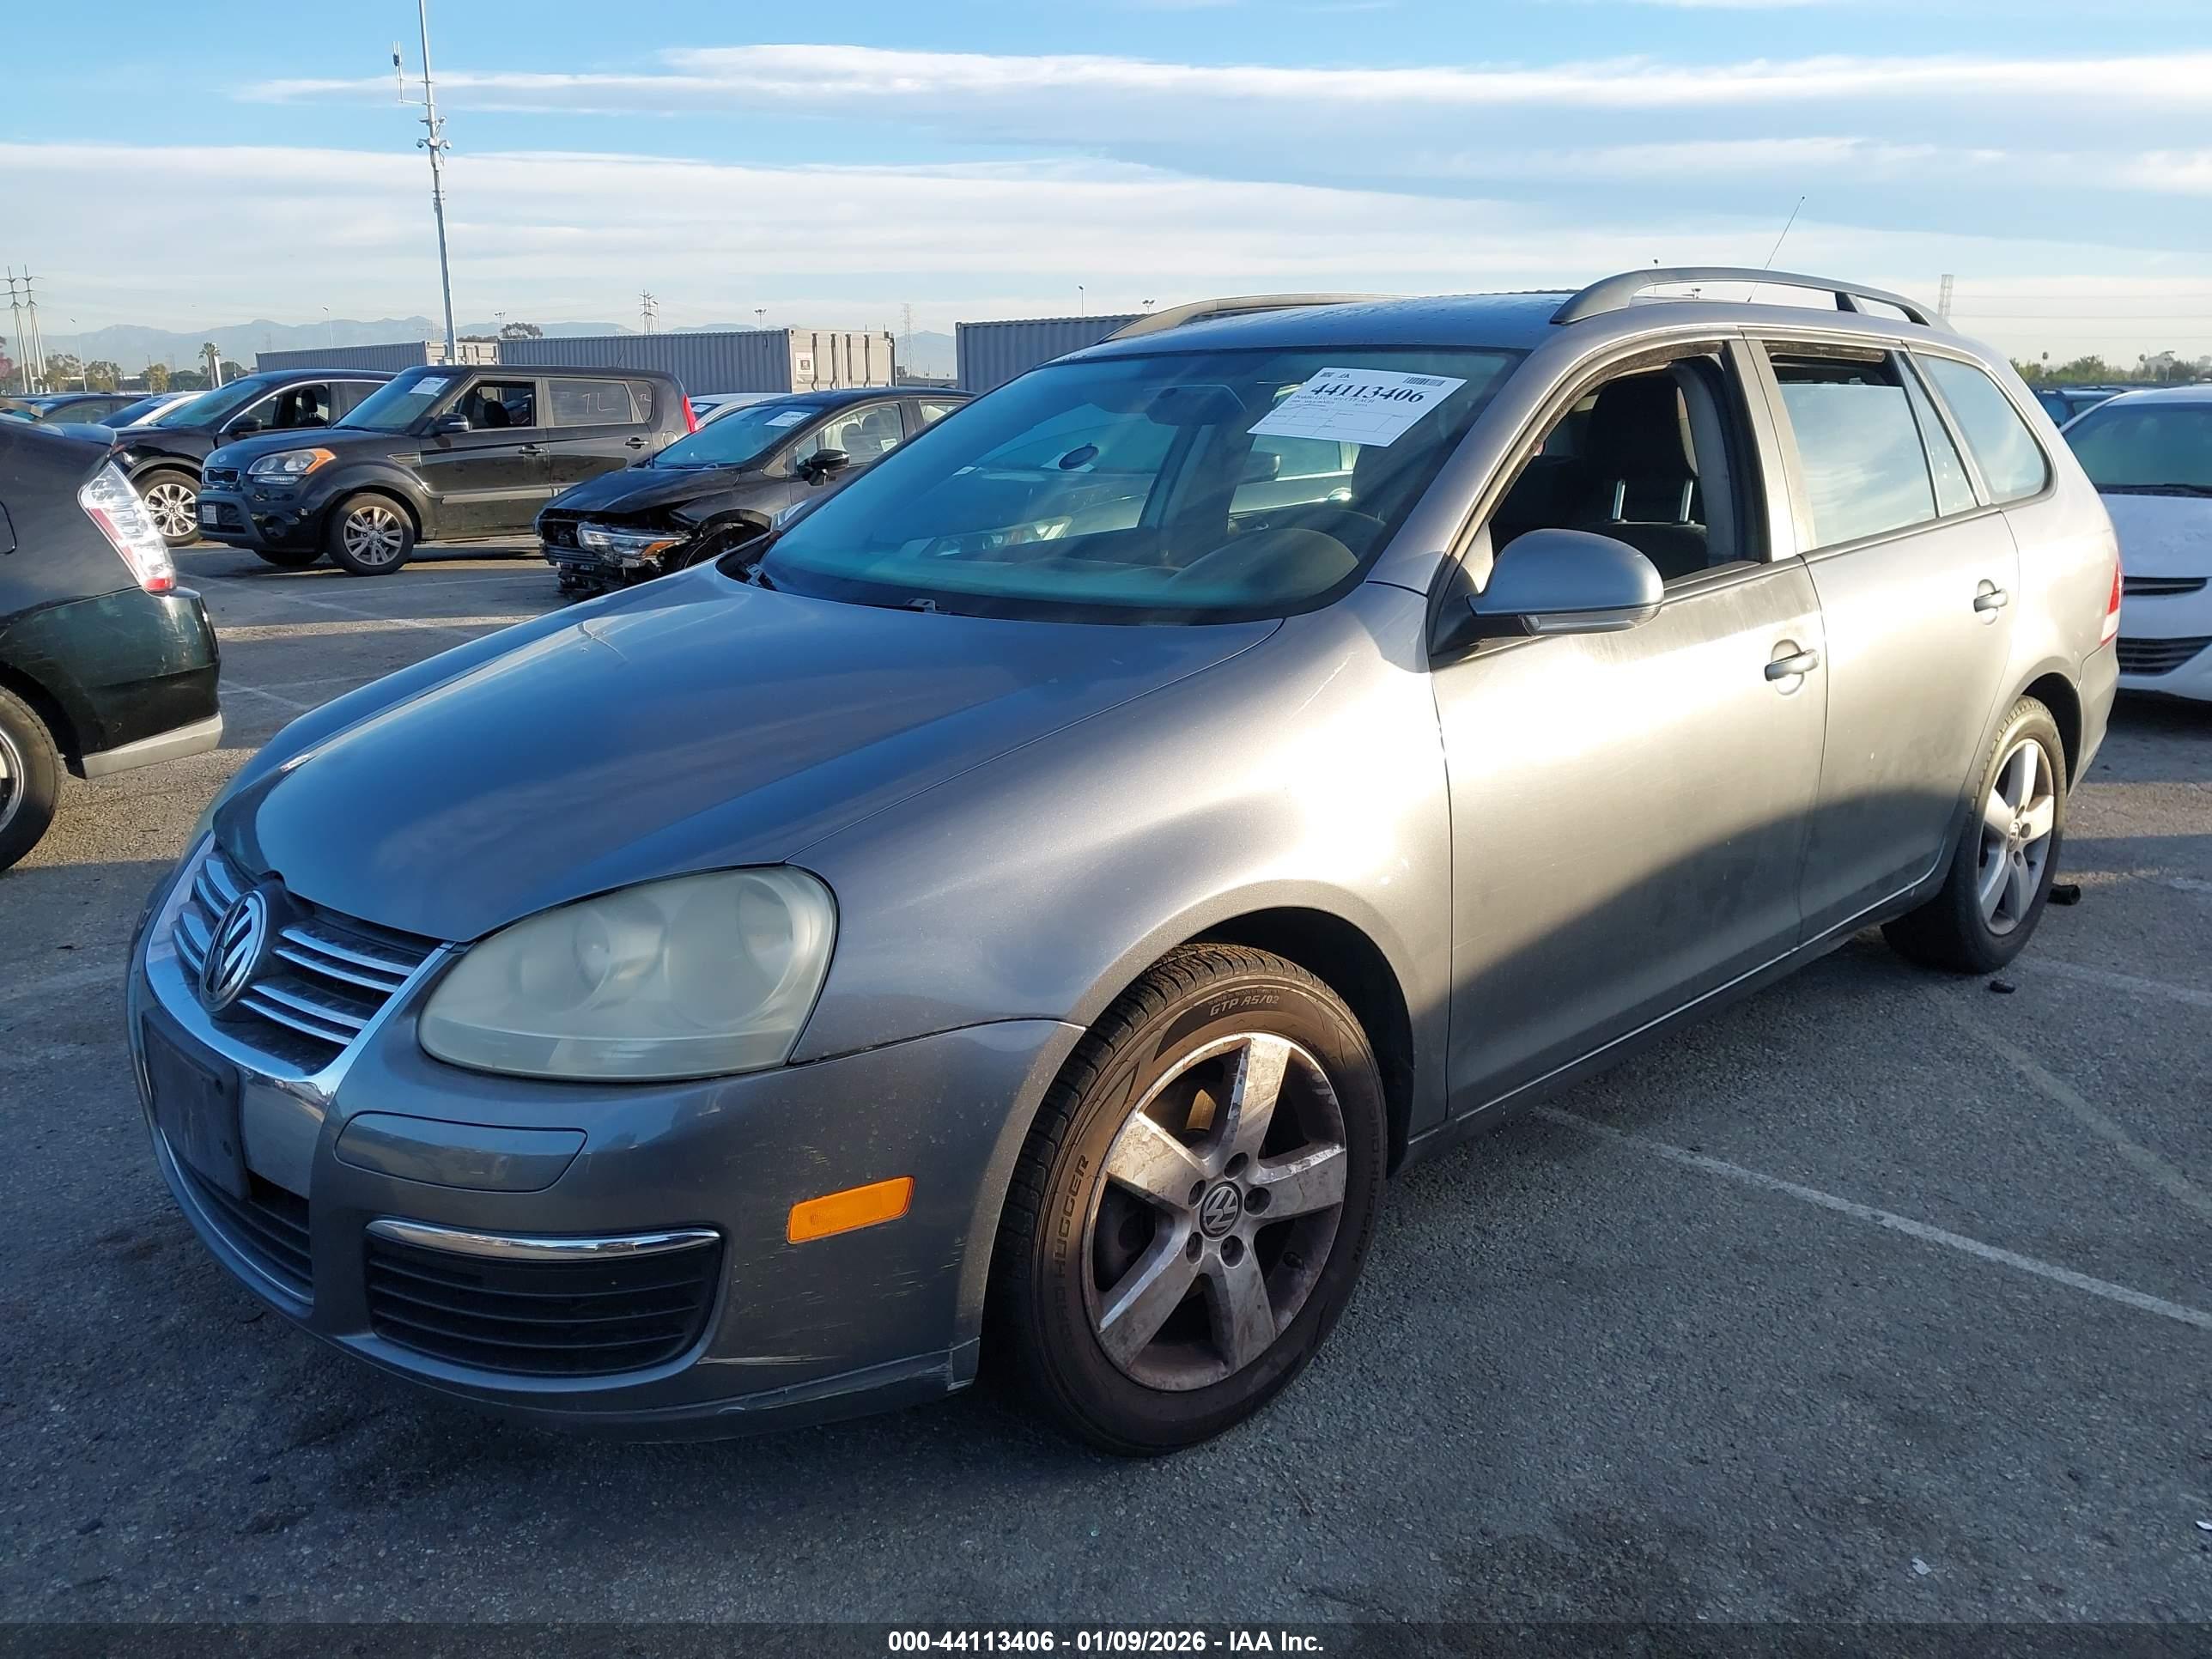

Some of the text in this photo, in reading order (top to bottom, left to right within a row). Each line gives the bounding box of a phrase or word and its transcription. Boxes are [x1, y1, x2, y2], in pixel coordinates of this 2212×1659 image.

[1310, 383, 1430, 403] 44113406
[1209, 998, 1239, 1017] GTP
[1053, 1154, 1089, 1279] HUGGER
